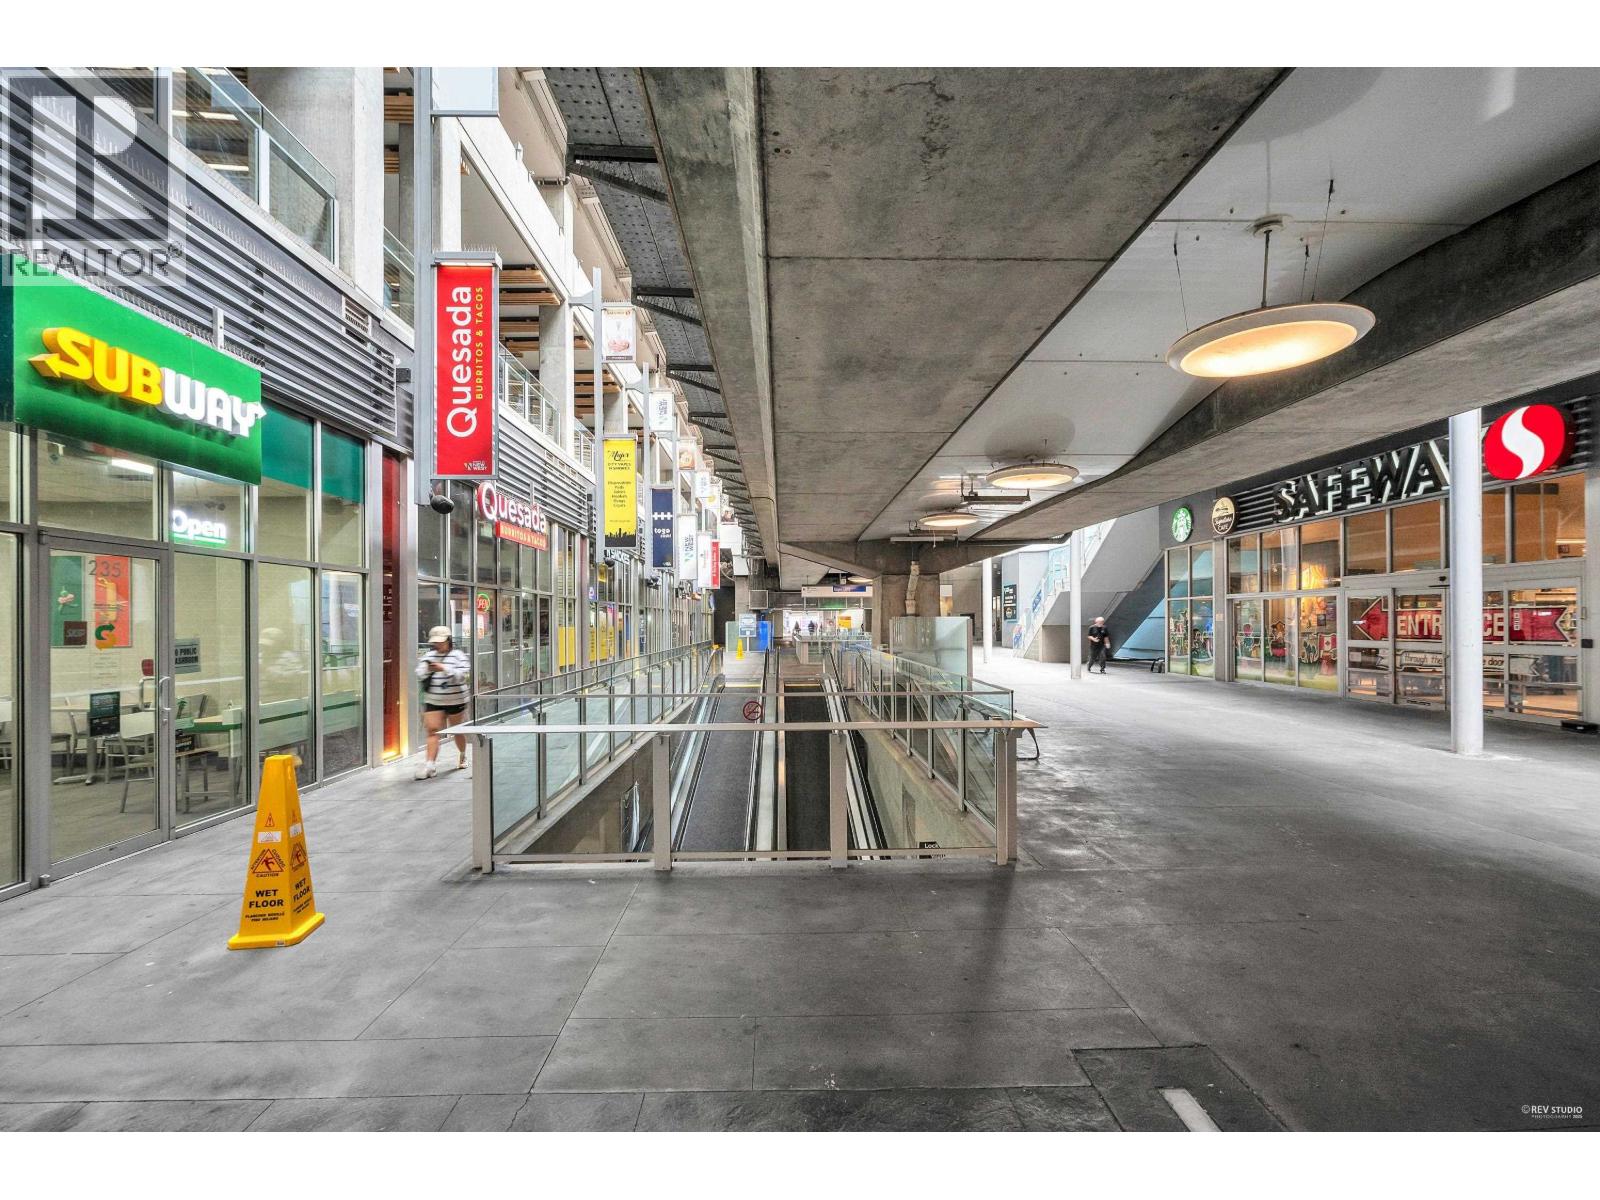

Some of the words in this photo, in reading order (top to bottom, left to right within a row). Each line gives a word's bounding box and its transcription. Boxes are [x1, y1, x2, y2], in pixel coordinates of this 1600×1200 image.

[475, 287, 484, 324] TACOS
[475, 329, 484, 337] &
[446, 286, 477, 438] Quesada
[475, 342, 484, 400] BURRITOS
[28, 327, 267, 437] SUBWAY
[1273, 437, 1450, 523] SAFEWA
[478, 481, 547, 534] Quesada
[172, 509, 227, 541] Open
[88, 559, 121, 577] 235
[255, 889, 279, 898] WET
[293, 886, 310, 902] FLOOR
[294, 877, 306, 890] WET
[248, 899, 284, 909] FLOOR
